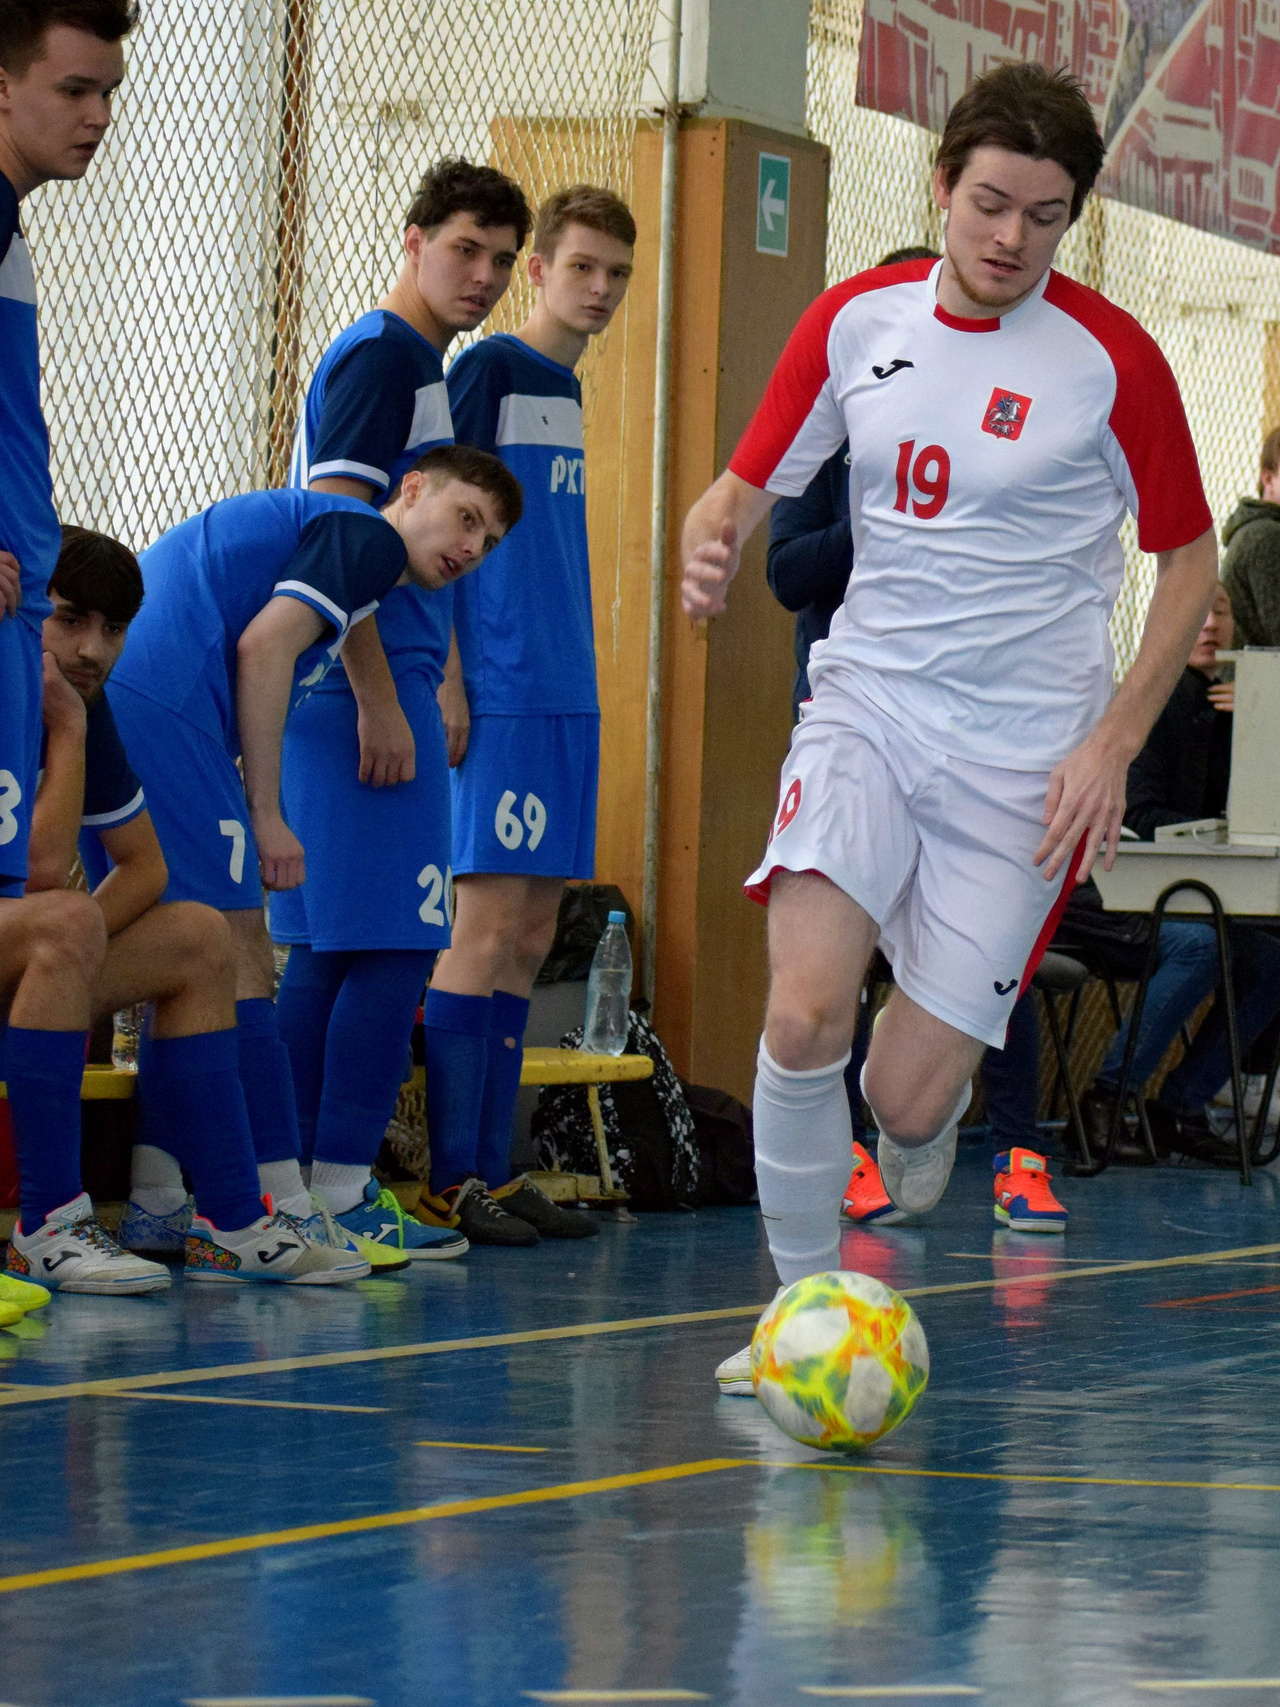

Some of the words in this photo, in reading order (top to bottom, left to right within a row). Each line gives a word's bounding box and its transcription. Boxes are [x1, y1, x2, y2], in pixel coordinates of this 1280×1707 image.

[893, 439, 951, 520] 19
[219, 819, 246, 884] 7
[495, 789, 547, 852] 69
